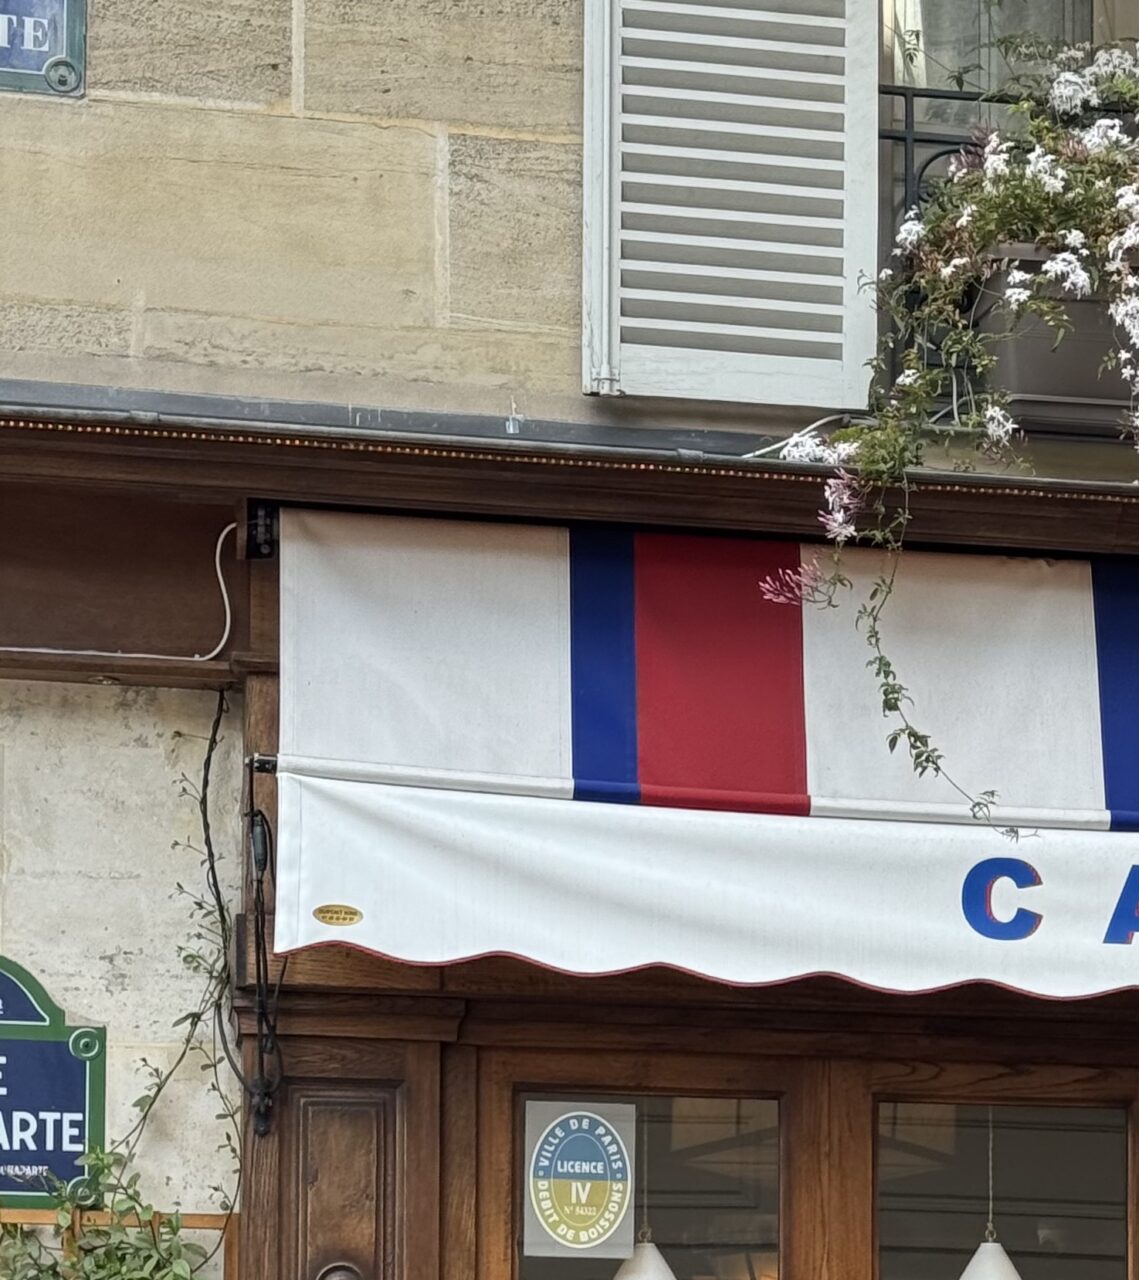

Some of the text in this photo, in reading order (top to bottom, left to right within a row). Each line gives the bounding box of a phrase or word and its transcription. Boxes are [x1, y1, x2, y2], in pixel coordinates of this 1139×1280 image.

[539, 1118, 623, 1169] VILLE DE PARIS
[558, 1160, 604, 1174] LICENCE
[537, 1180, 624, 1242] DEBIT DE BOISSONS
[571, 1181, 591, 1205] IV
